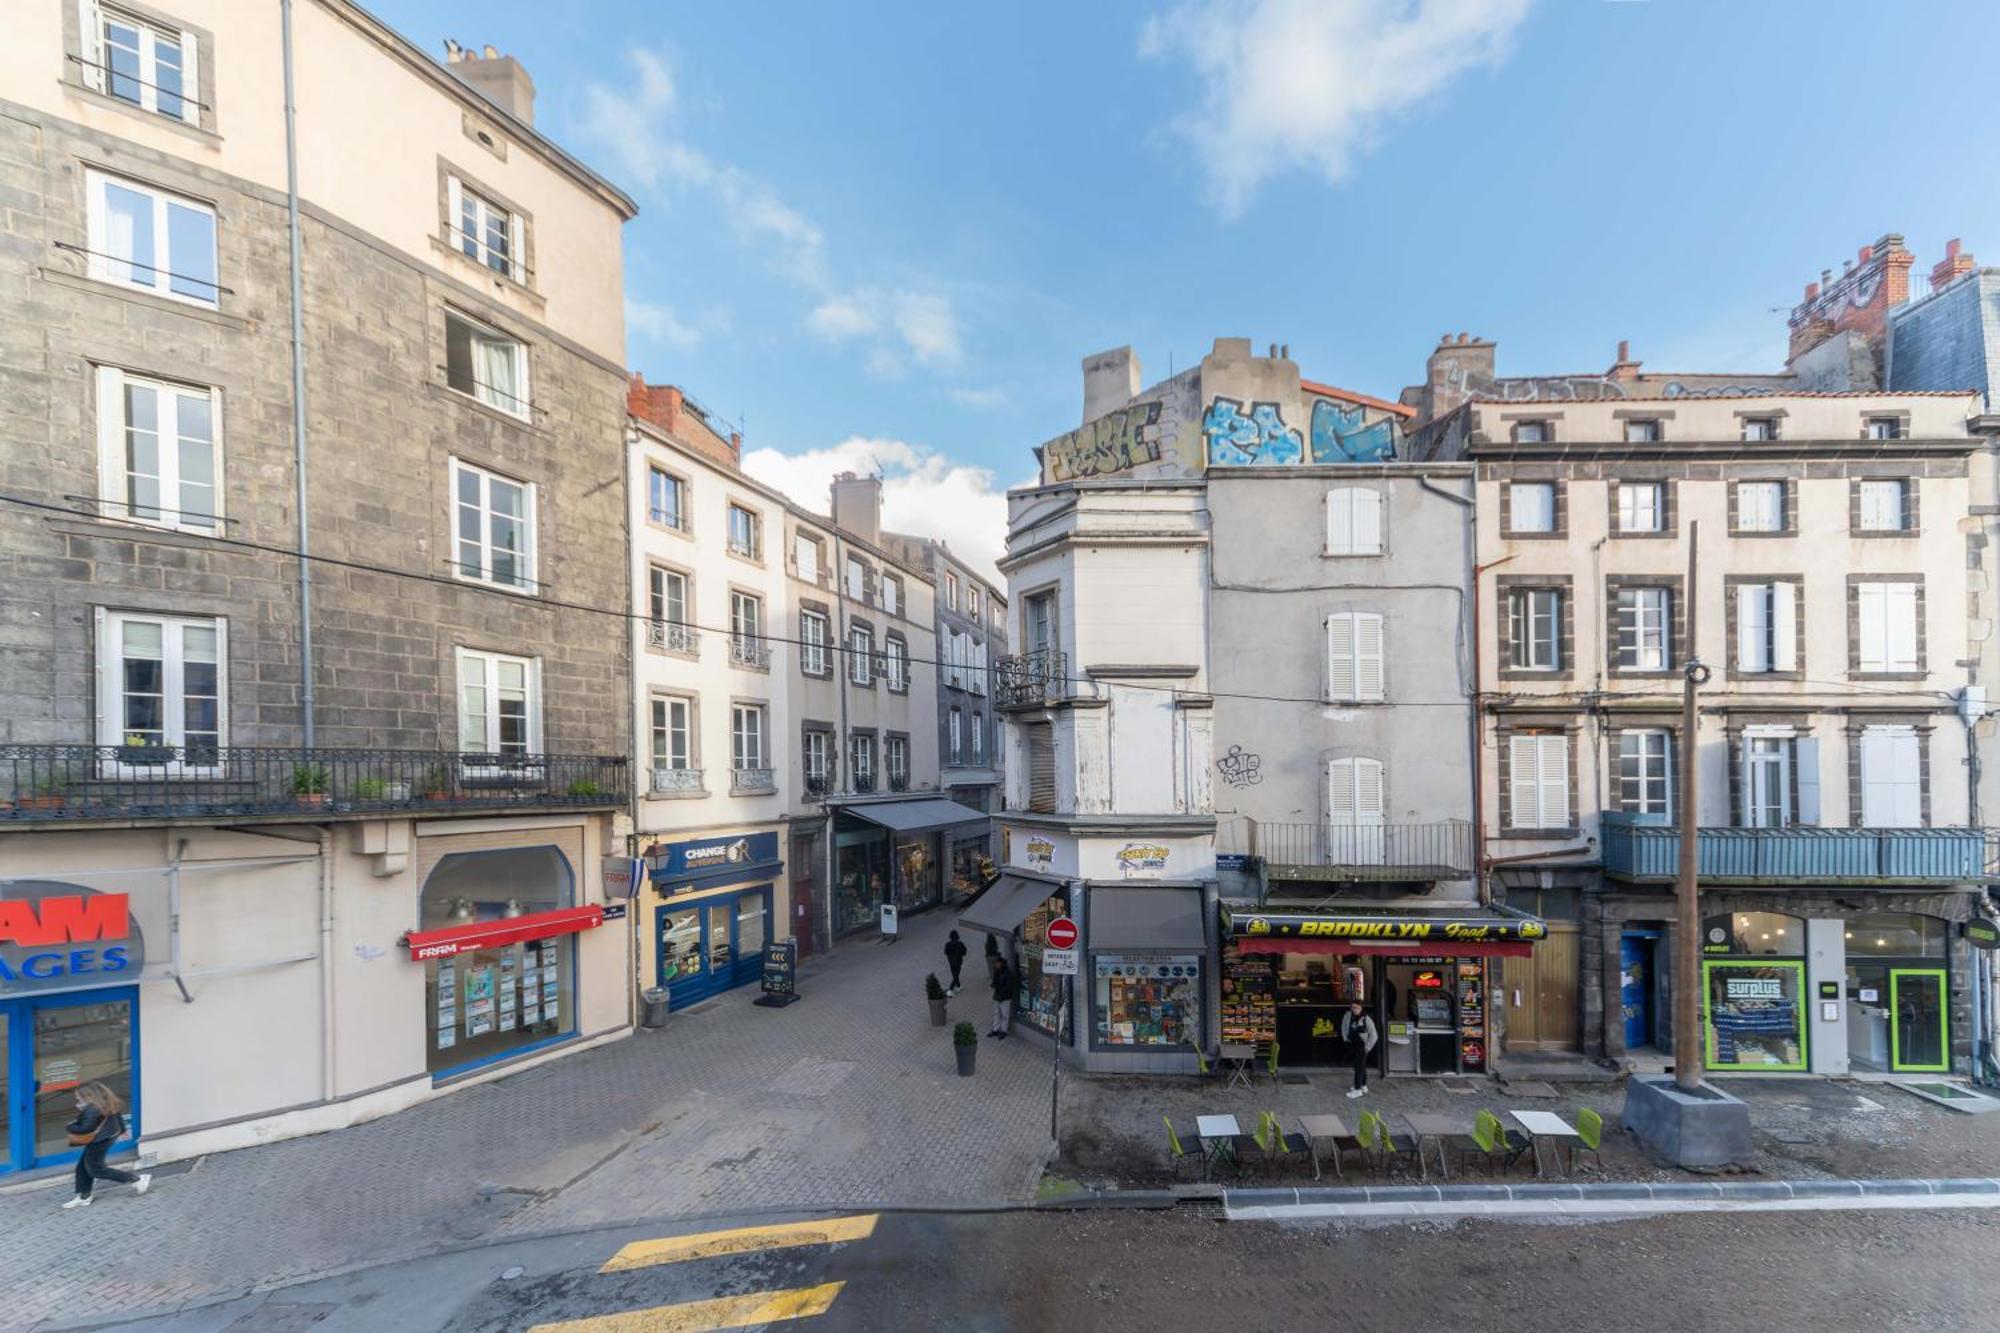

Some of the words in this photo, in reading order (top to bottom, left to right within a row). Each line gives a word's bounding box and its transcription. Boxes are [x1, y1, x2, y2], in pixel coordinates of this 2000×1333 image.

[685, 845, 727, 859] CHANGE
[1300, 921, 1431, 937] BROOKLYN
[1445, 922, 1489, 938] Food
[419, 943, 457, 959] FRAM
[1727, 978, 1780, 997] surplus
